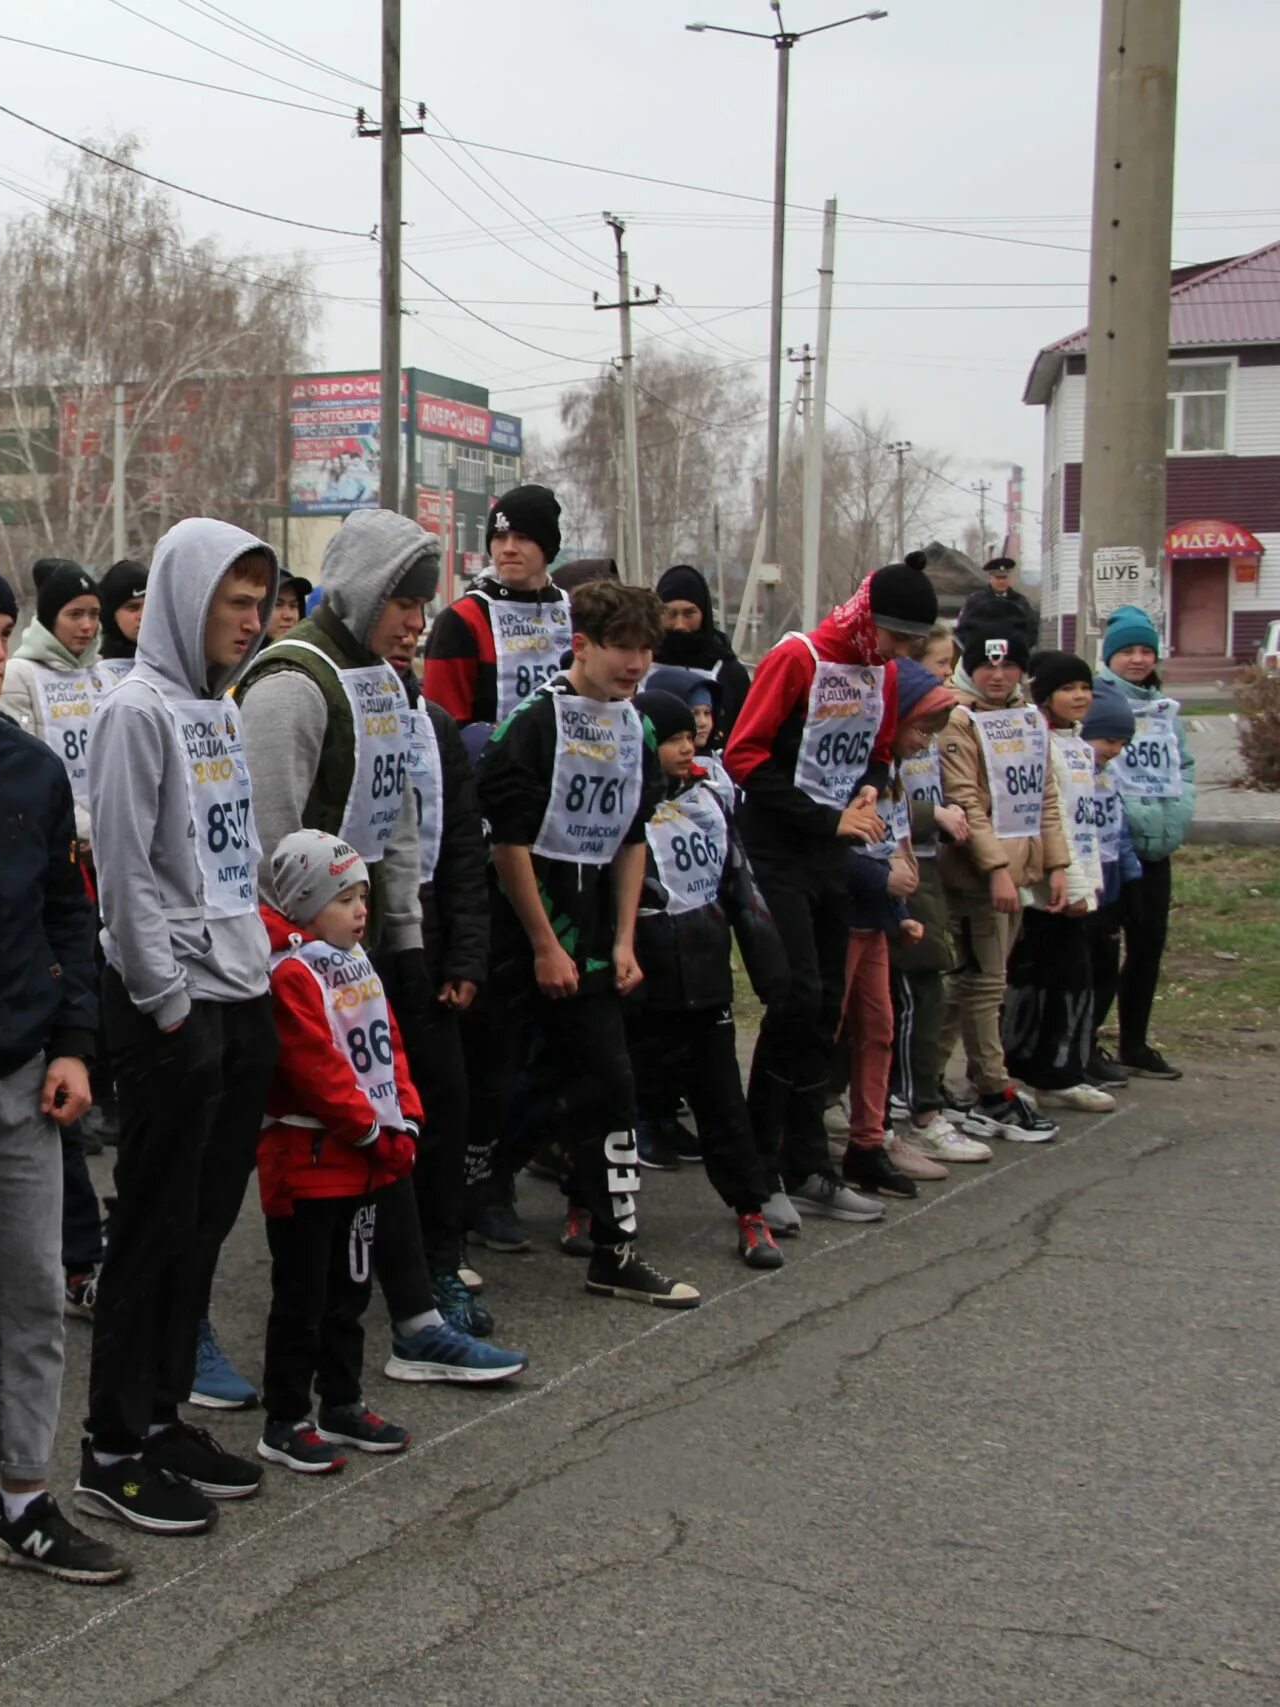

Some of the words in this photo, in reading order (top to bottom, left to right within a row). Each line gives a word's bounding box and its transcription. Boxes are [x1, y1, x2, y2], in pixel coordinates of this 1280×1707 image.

[1171, 532, 1246, 549] ИДЕАЛ
[1096, 565, 1140, 581] ШУБ
[816, 731, 872, 767] 8605
[1125, 741, 1171, 769] 8561
[372, 750, 410, 800] 856
[1005, 763, 1043, 797] 8642
[565, 773, 627, 815] 8761
[670, 831, 722, 873] 866
[333, 978, 382, 1014] 2020
[346, 1018, 393, 1074] 86
